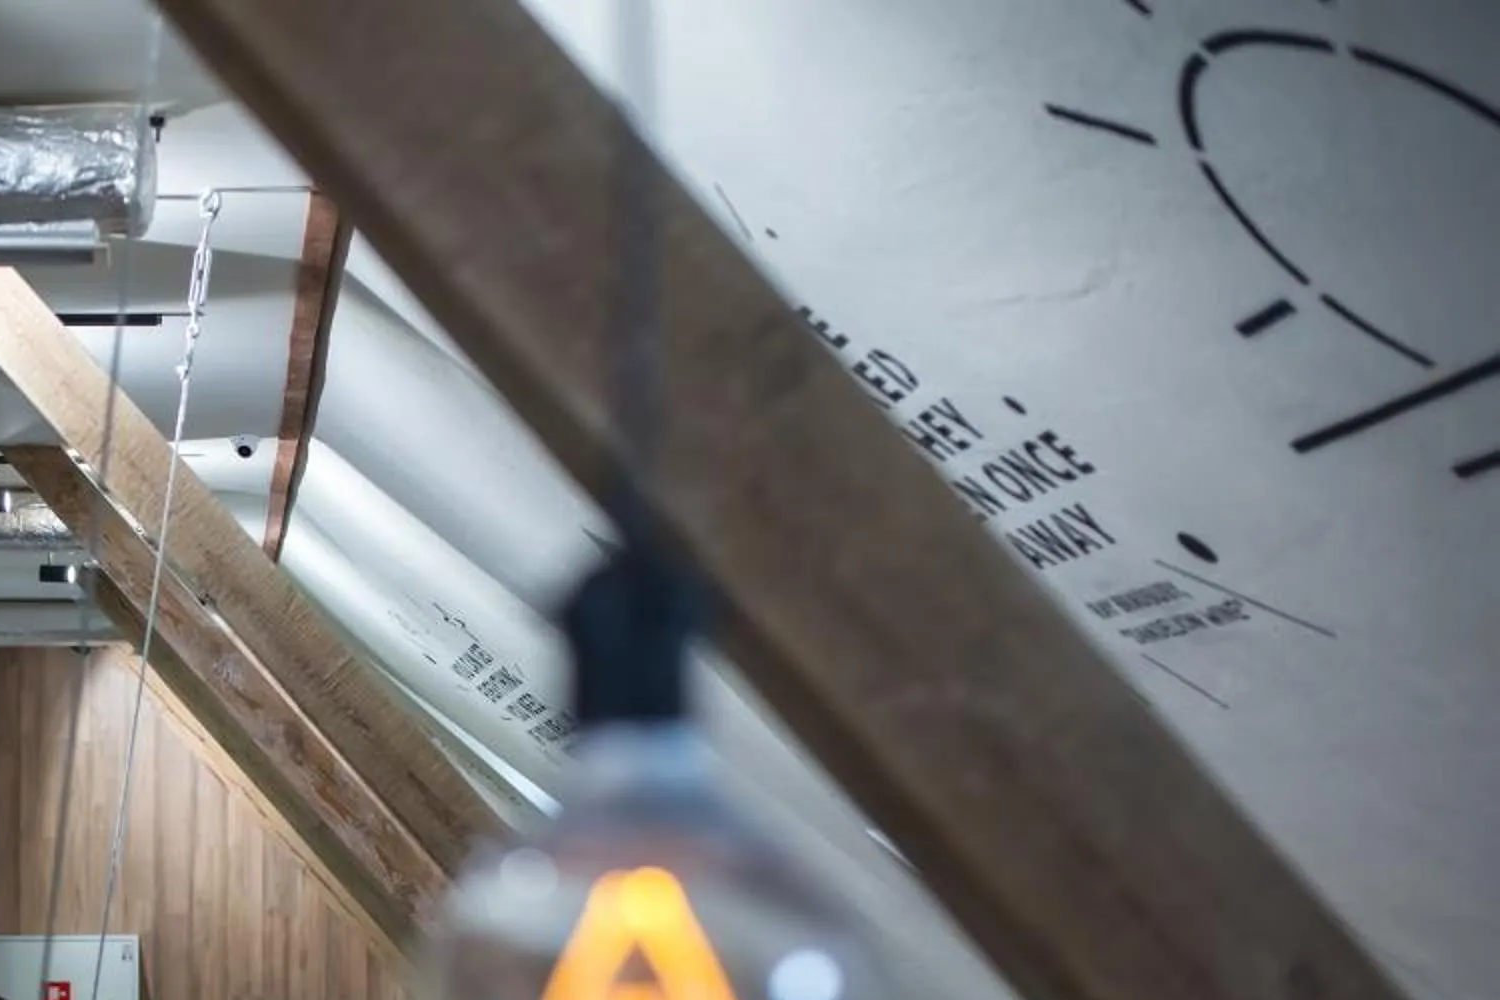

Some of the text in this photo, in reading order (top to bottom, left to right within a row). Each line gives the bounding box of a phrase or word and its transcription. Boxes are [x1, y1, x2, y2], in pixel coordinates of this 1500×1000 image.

[852, 348, 920, 410] ED
[902, 397, 985, 463] HEY
[982, 430, 1097, 503] ONCE
[1005, 502, 1117, 570] AWAY
